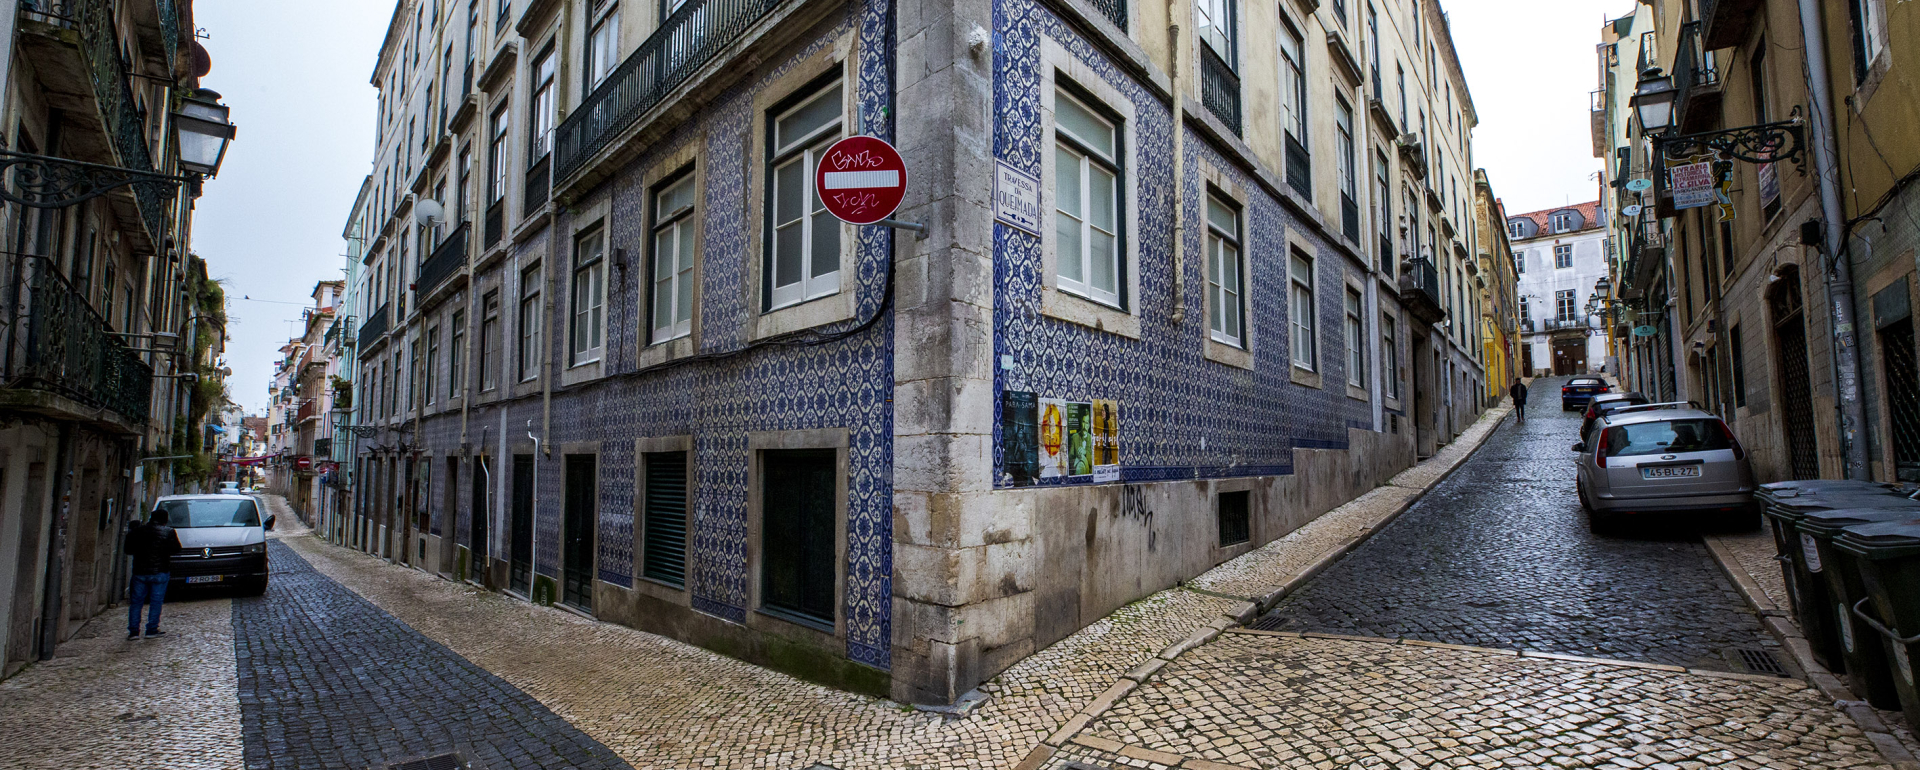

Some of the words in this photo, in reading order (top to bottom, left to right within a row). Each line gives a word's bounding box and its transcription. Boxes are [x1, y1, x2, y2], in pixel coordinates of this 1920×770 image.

[1672, 163, 1708, 174] LIVRARIA
[1004, 172, 1033, 192] TRAVESSA
[1687, 179, 1711, 188] SILVA
[1014, 187, 1022, 196] DA
[999, 190, 1037, 219] QUEIMADA
[1650, 467, 1693, 477] 45-BL-27
